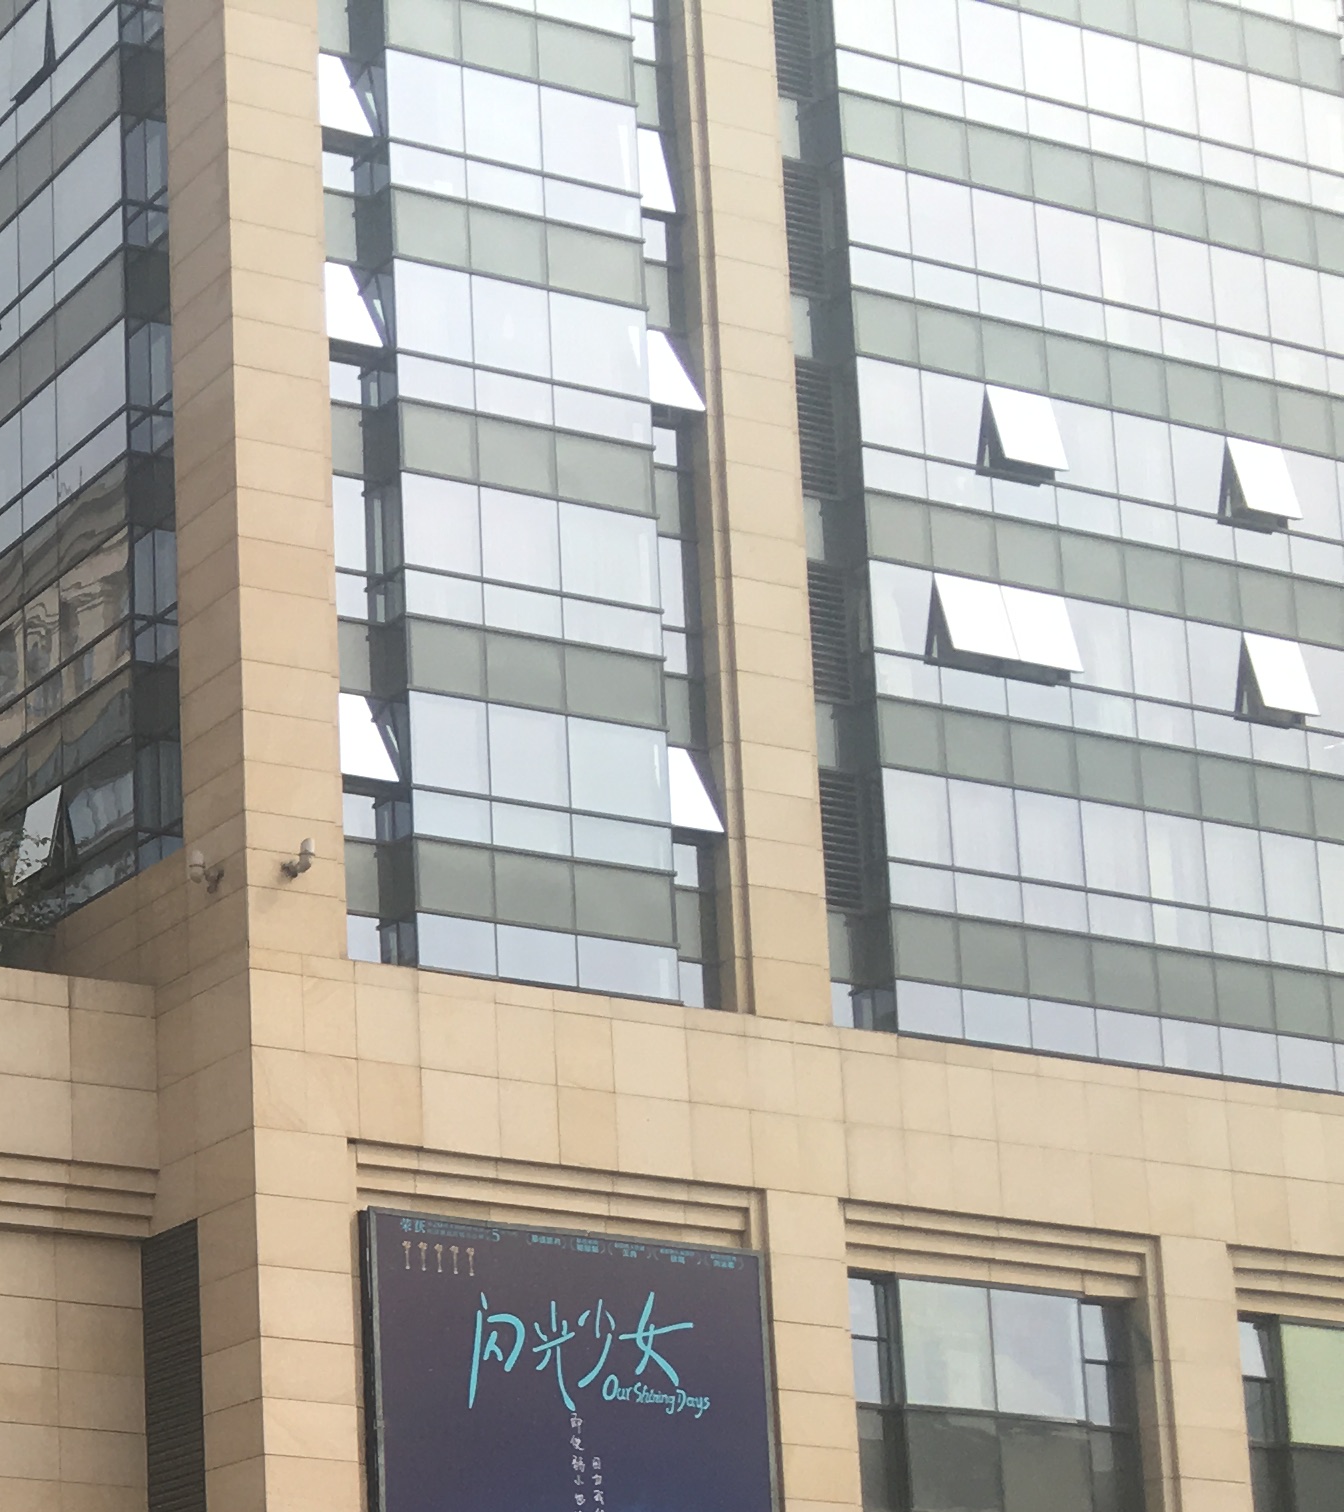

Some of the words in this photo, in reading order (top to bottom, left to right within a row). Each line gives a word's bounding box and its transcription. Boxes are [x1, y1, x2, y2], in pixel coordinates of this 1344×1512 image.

[468, 1291, 694, 1411] 闪光少女
[602, 1374, 632, 1401] Our
[634, 1382, 675, 1414] Shining
[676, 1389, 711, 1418] Days
